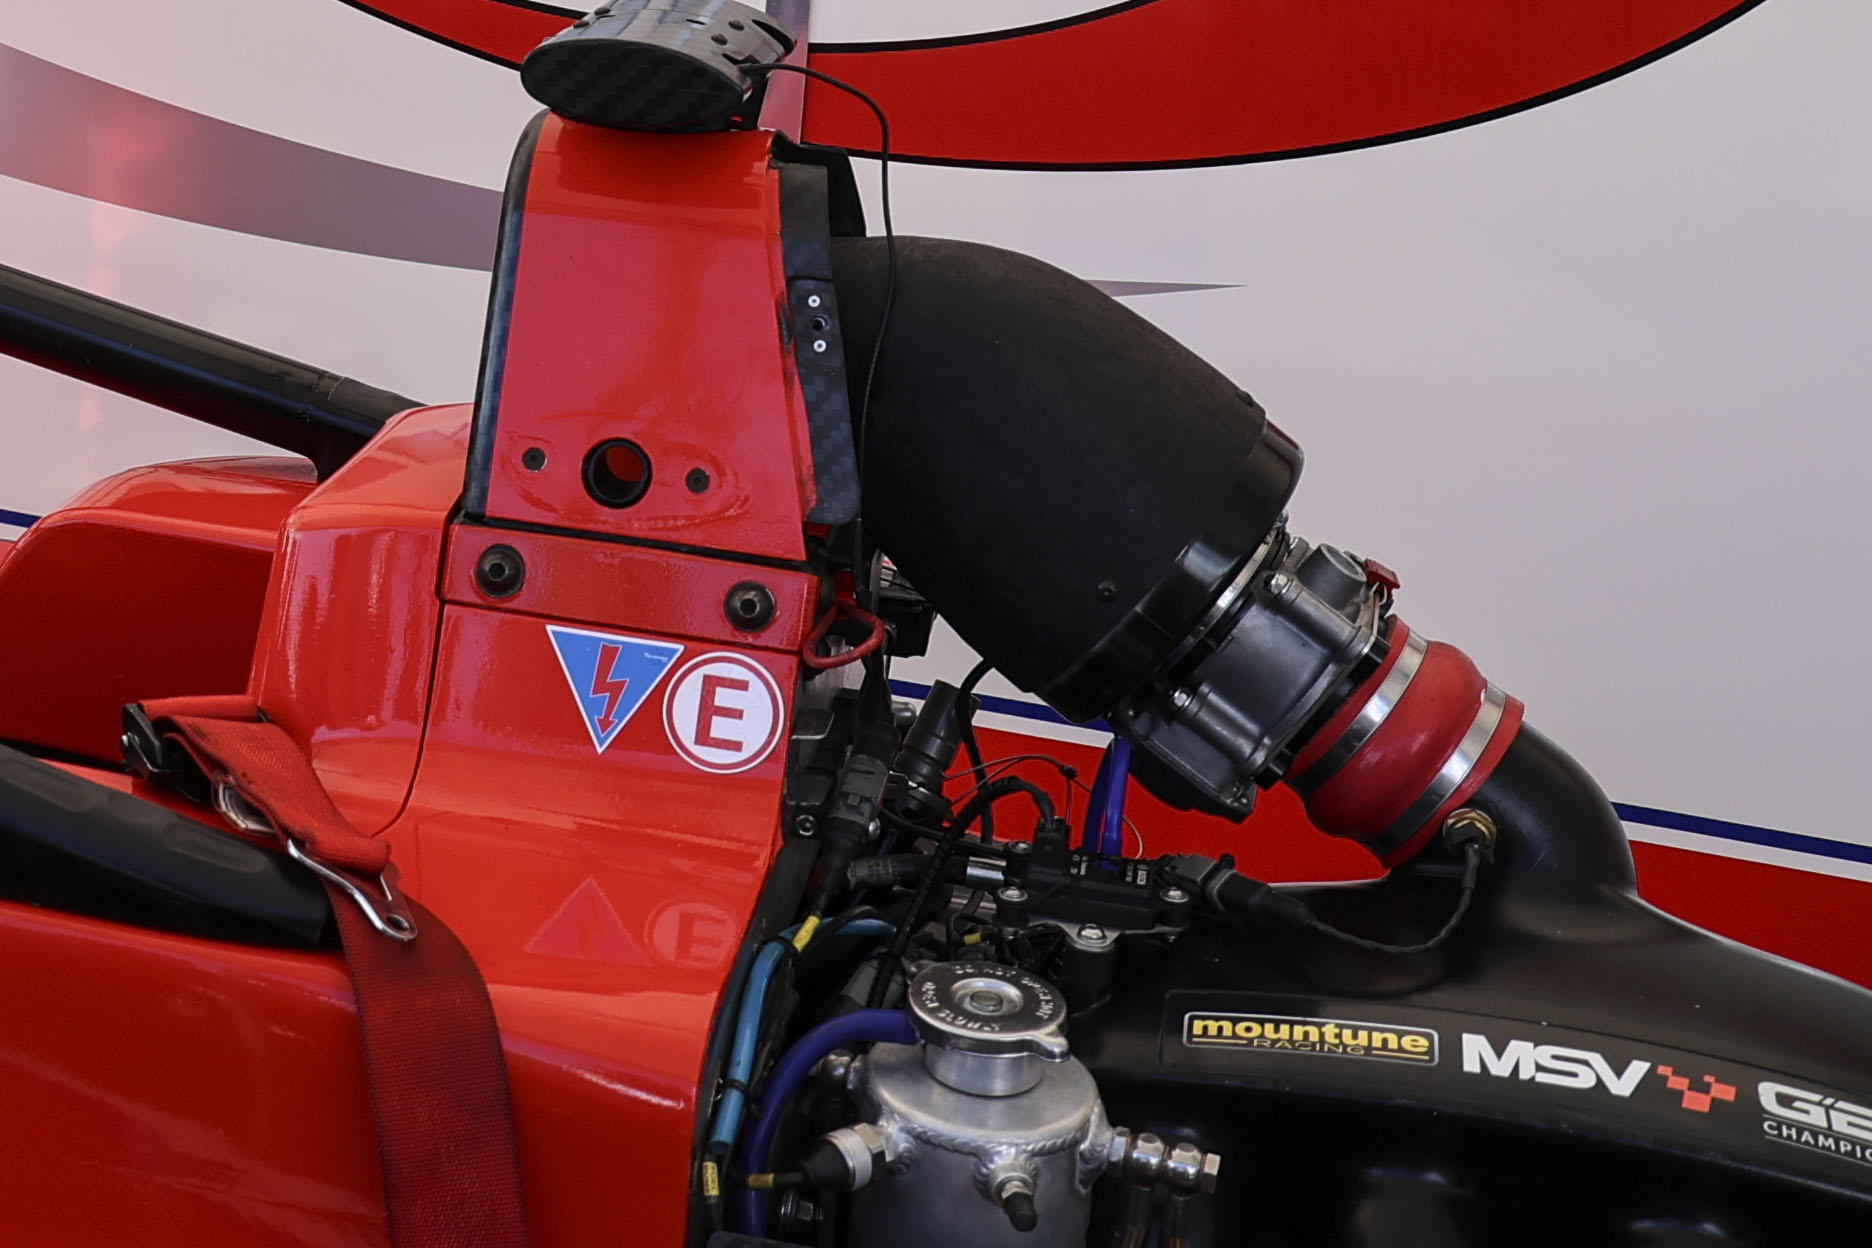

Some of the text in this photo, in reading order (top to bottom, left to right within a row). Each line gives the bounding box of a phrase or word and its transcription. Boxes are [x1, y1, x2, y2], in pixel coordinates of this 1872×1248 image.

[694, 673, 750, 753] E
[1191, 1018, 1431, 1053] mountune
[1252, 1038, 1366, 1056] RACING
[1461, 1032, 1653, 1098] MSV
